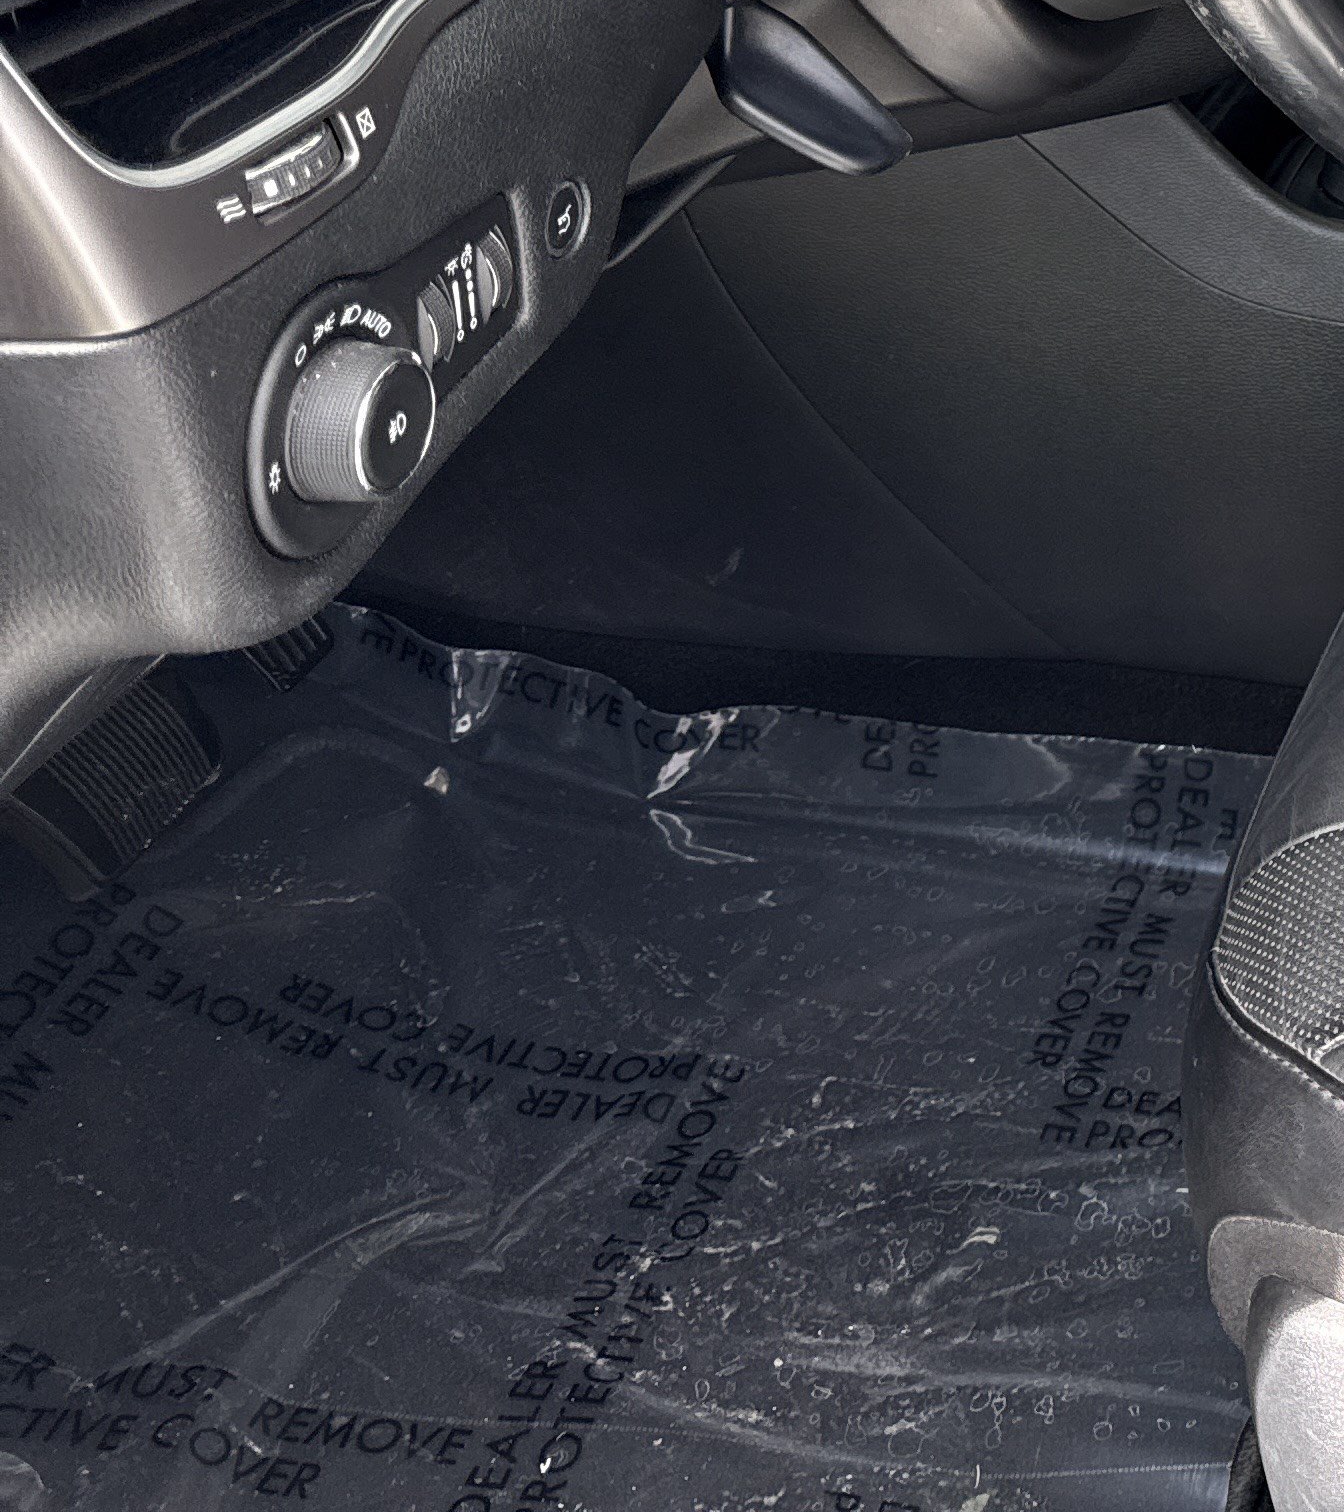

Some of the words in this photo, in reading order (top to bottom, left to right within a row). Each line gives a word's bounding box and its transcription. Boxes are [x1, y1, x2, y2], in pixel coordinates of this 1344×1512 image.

[360, 304, 392, 339] AUTO
[0, 881, 138, 1038] PROTEC
[49, 903, 184, 1038] DEALER
[1112, 912, 1177, 999] MUST
[145, 967, 345, 1061] REMOVE
[278, 973, 429, 1043] COVER
[446, 1022, 703, 1083] PROTECTIVE
[1025, 963, 1103, 1069] COVER
[356, 1047, 495, 1104] MUST
[515, 1085, 678, 1125] DEALER
[1039, 1011, 1132, 1146] REMOVE
[559, 1232, 644, 1341] MUST
[627, 1057, 748, 1212] REMOVE
[248, 1396, 474, 1466] REMOVE
[516, 1279, 665, 1512] ROTECTIVE
[151, 1412, 322, 1501] COVER
